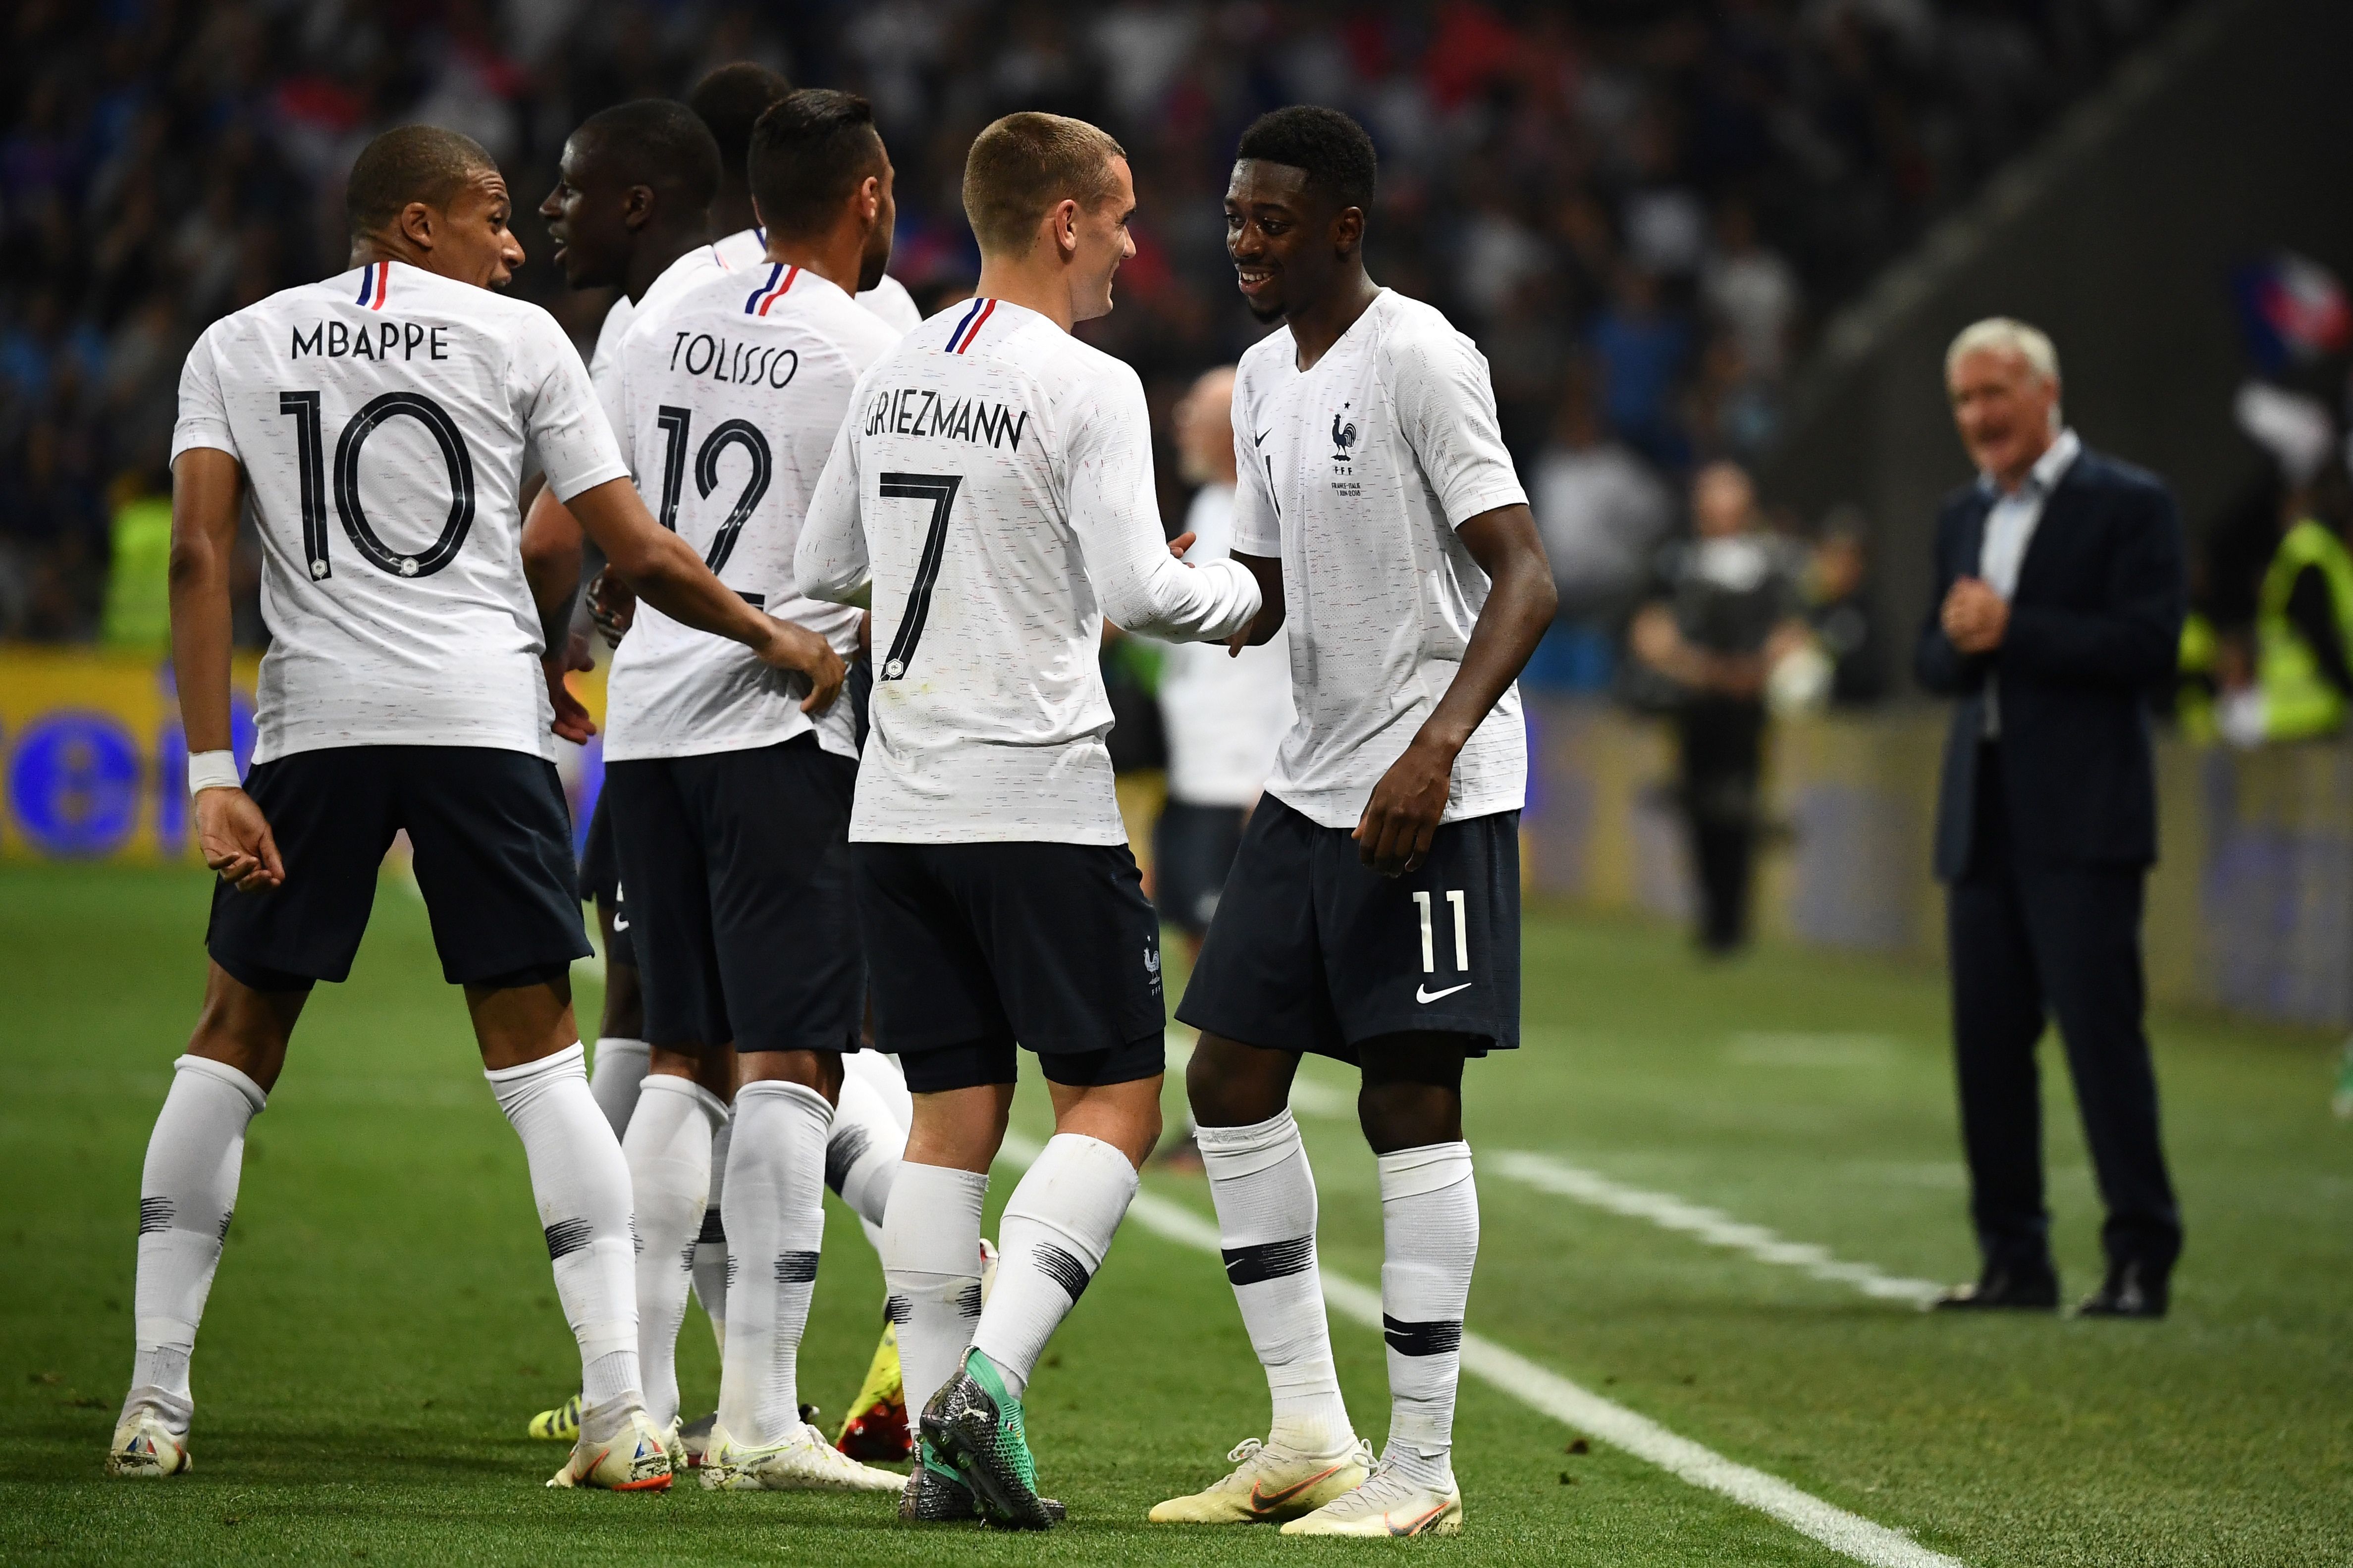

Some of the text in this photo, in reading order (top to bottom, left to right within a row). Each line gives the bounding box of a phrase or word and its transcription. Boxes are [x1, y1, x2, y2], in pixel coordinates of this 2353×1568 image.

[291, 320, 448, 361] MBAPPE
[670, 332, 799, 389] TOLISSO
[865, 388, 1027, 454] GRIEZMANN
[280, 390, 476, 581] 10
[657, 405, 773, 610] 12
[1335, 466, 1352, 475] FFF
[879, 472, 964, 682] 7
[1413, 890, 1468, 973] 11
